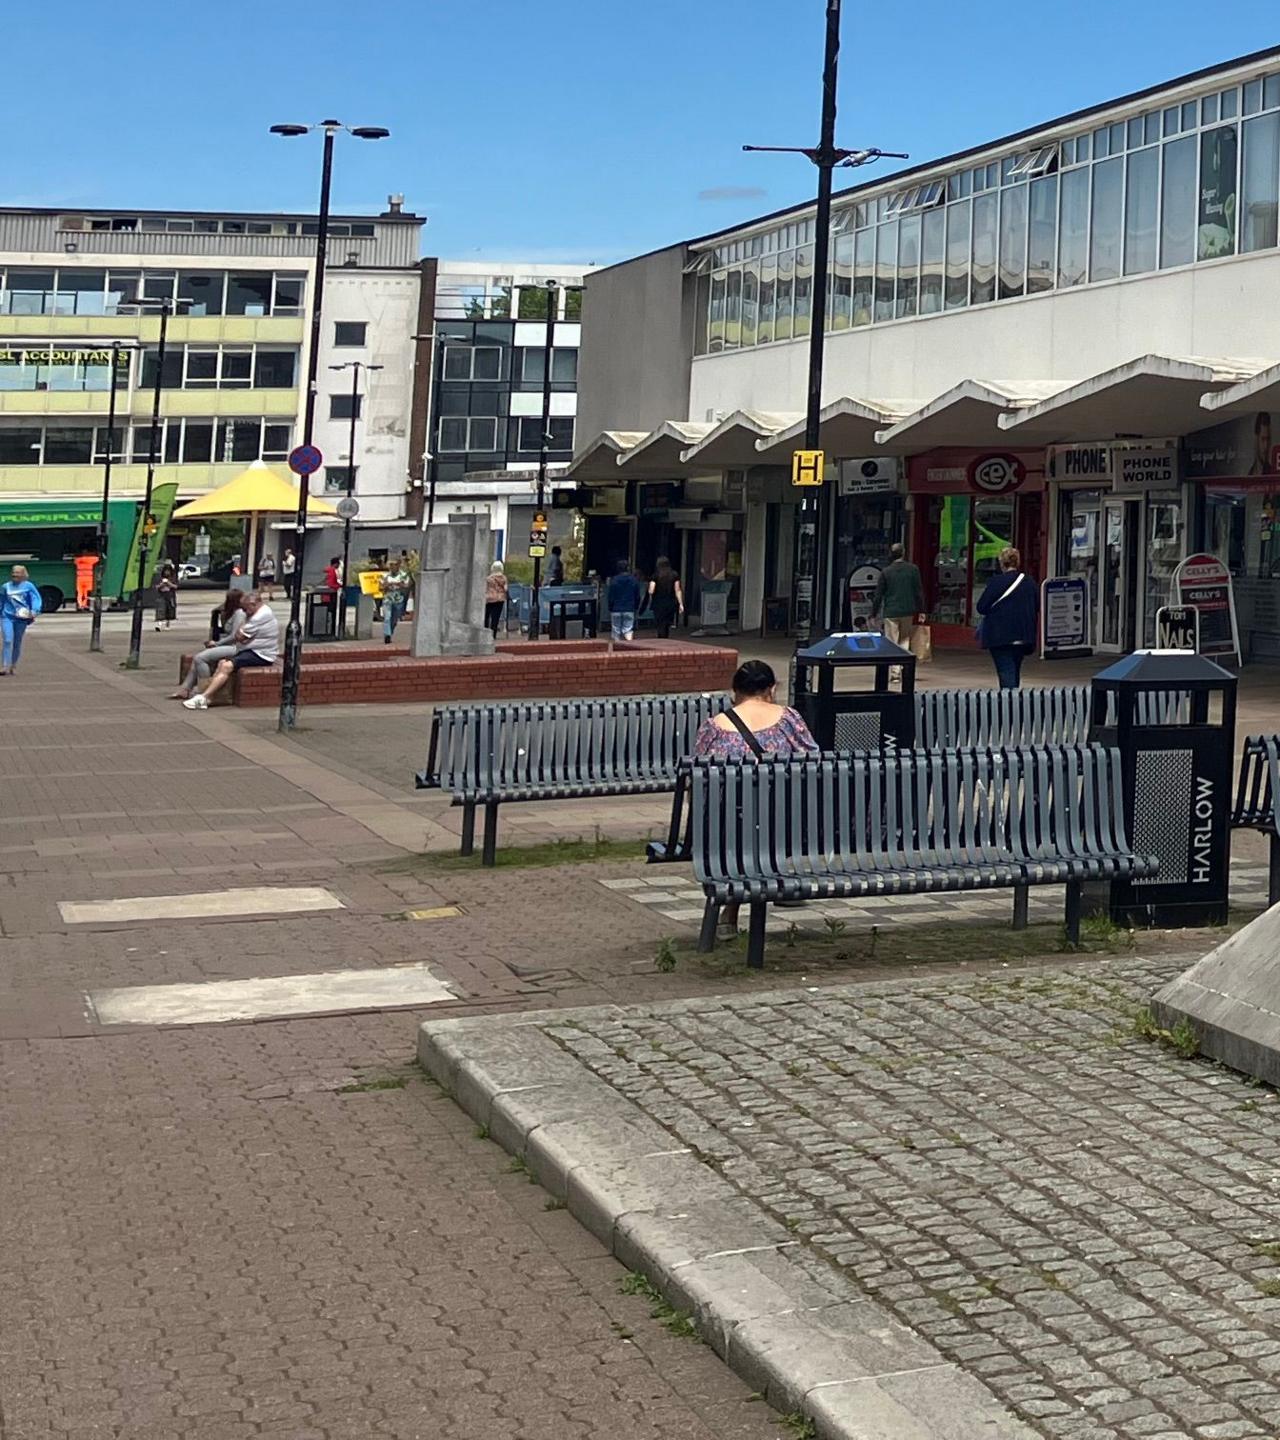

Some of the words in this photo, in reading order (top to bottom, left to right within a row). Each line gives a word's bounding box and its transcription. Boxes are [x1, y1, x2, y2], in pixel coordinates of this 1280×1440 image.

[21, 350, 128, 361] ACCOUNTANS
[1065, 448, 1107, 474] PHONE
[1123, 457, 1171, 469] PHONE
[798, 455, 819, 482] H
[1123, 470, 1172, 482] WORLD
[1186, 566, 1220, 576] CELLY'S
[1189, 591, 1220, 600] CELLY'S
[1192, 776, 1215, 883] HARLOW
